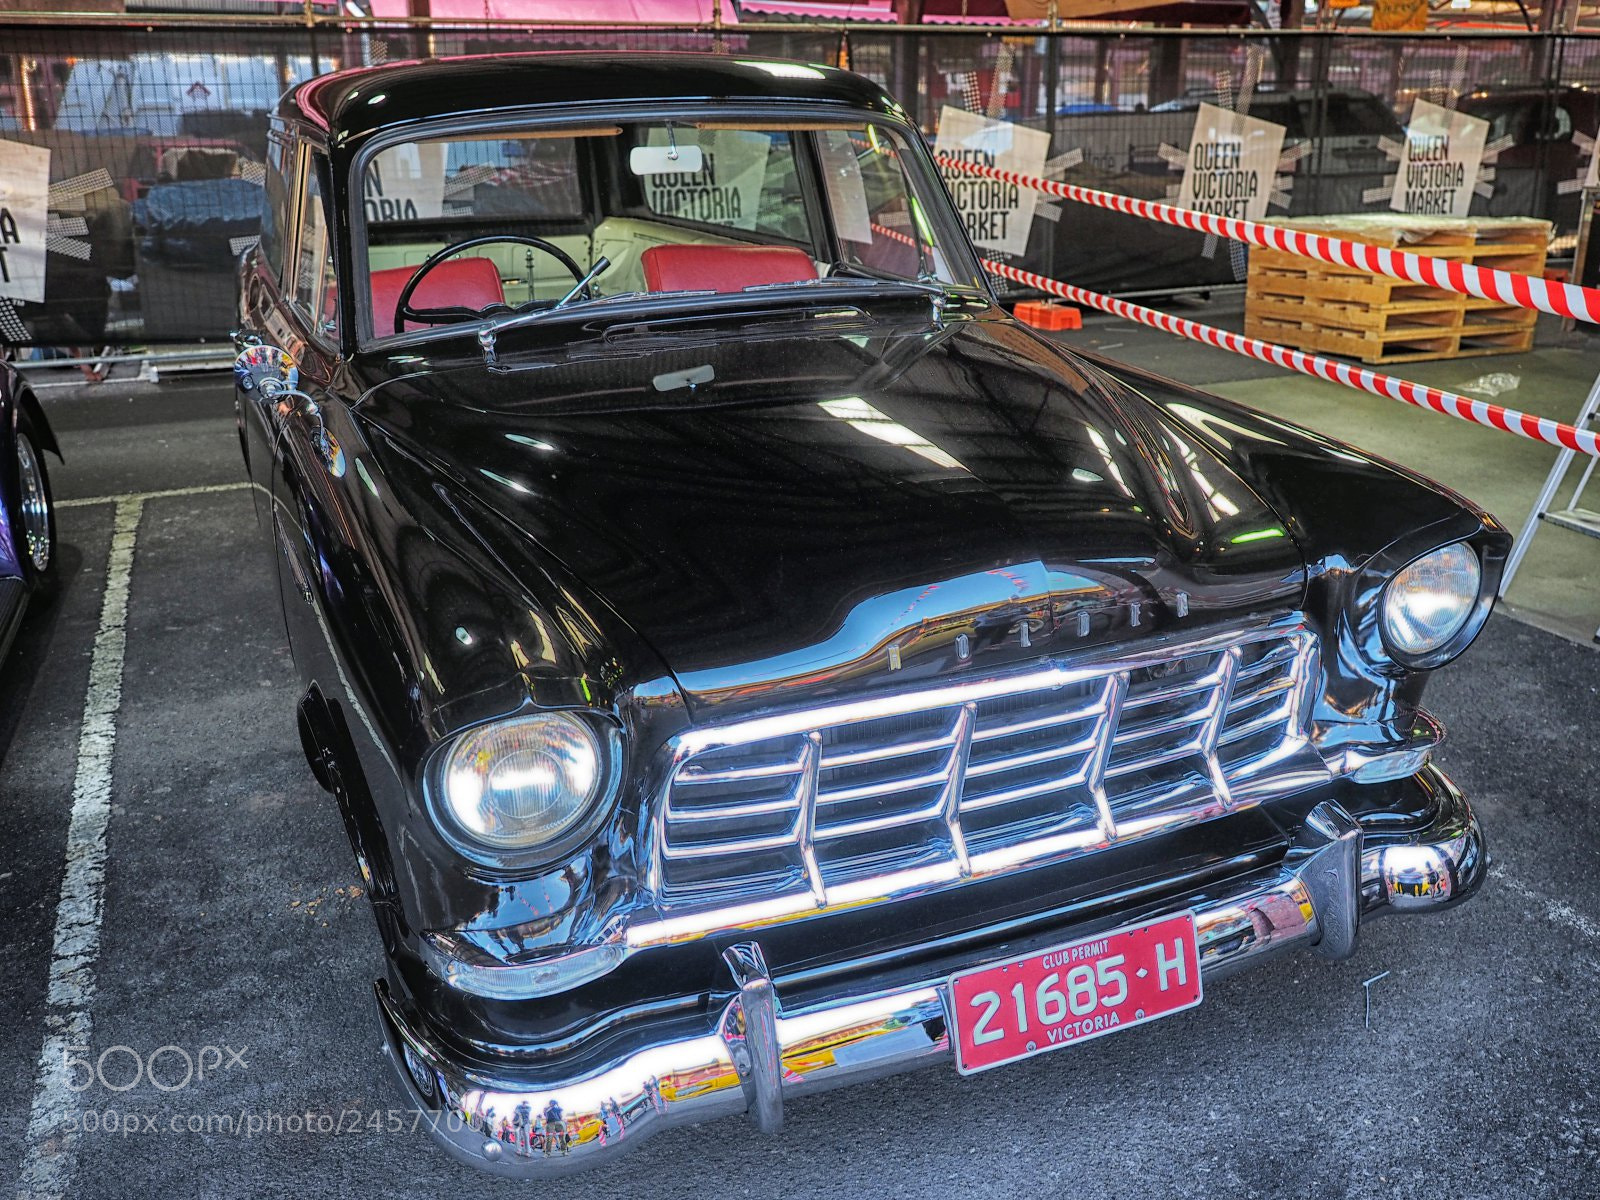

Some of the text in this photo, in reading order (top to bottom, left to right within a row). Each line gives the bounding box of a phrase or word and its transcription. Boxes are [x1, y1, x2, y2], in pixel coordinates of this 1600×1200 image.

[1193, 142, 1242, 171] QUEEN
[1408, 135, 1450, 162] QUEEN
[1192, 170, 1259, 200] VICTORIA
[1406, 162, 1465, 189] VICTORIA
[945, 180, 1019, 210] ICTORIA
[1404, 189, 1457, 215] MARKET
[964, 210, 1010, 241] RKET
[1042, 939, 1110, 970] CLUB PERMIT
[1046, 1011, 1120, 1044] VICTORIA
